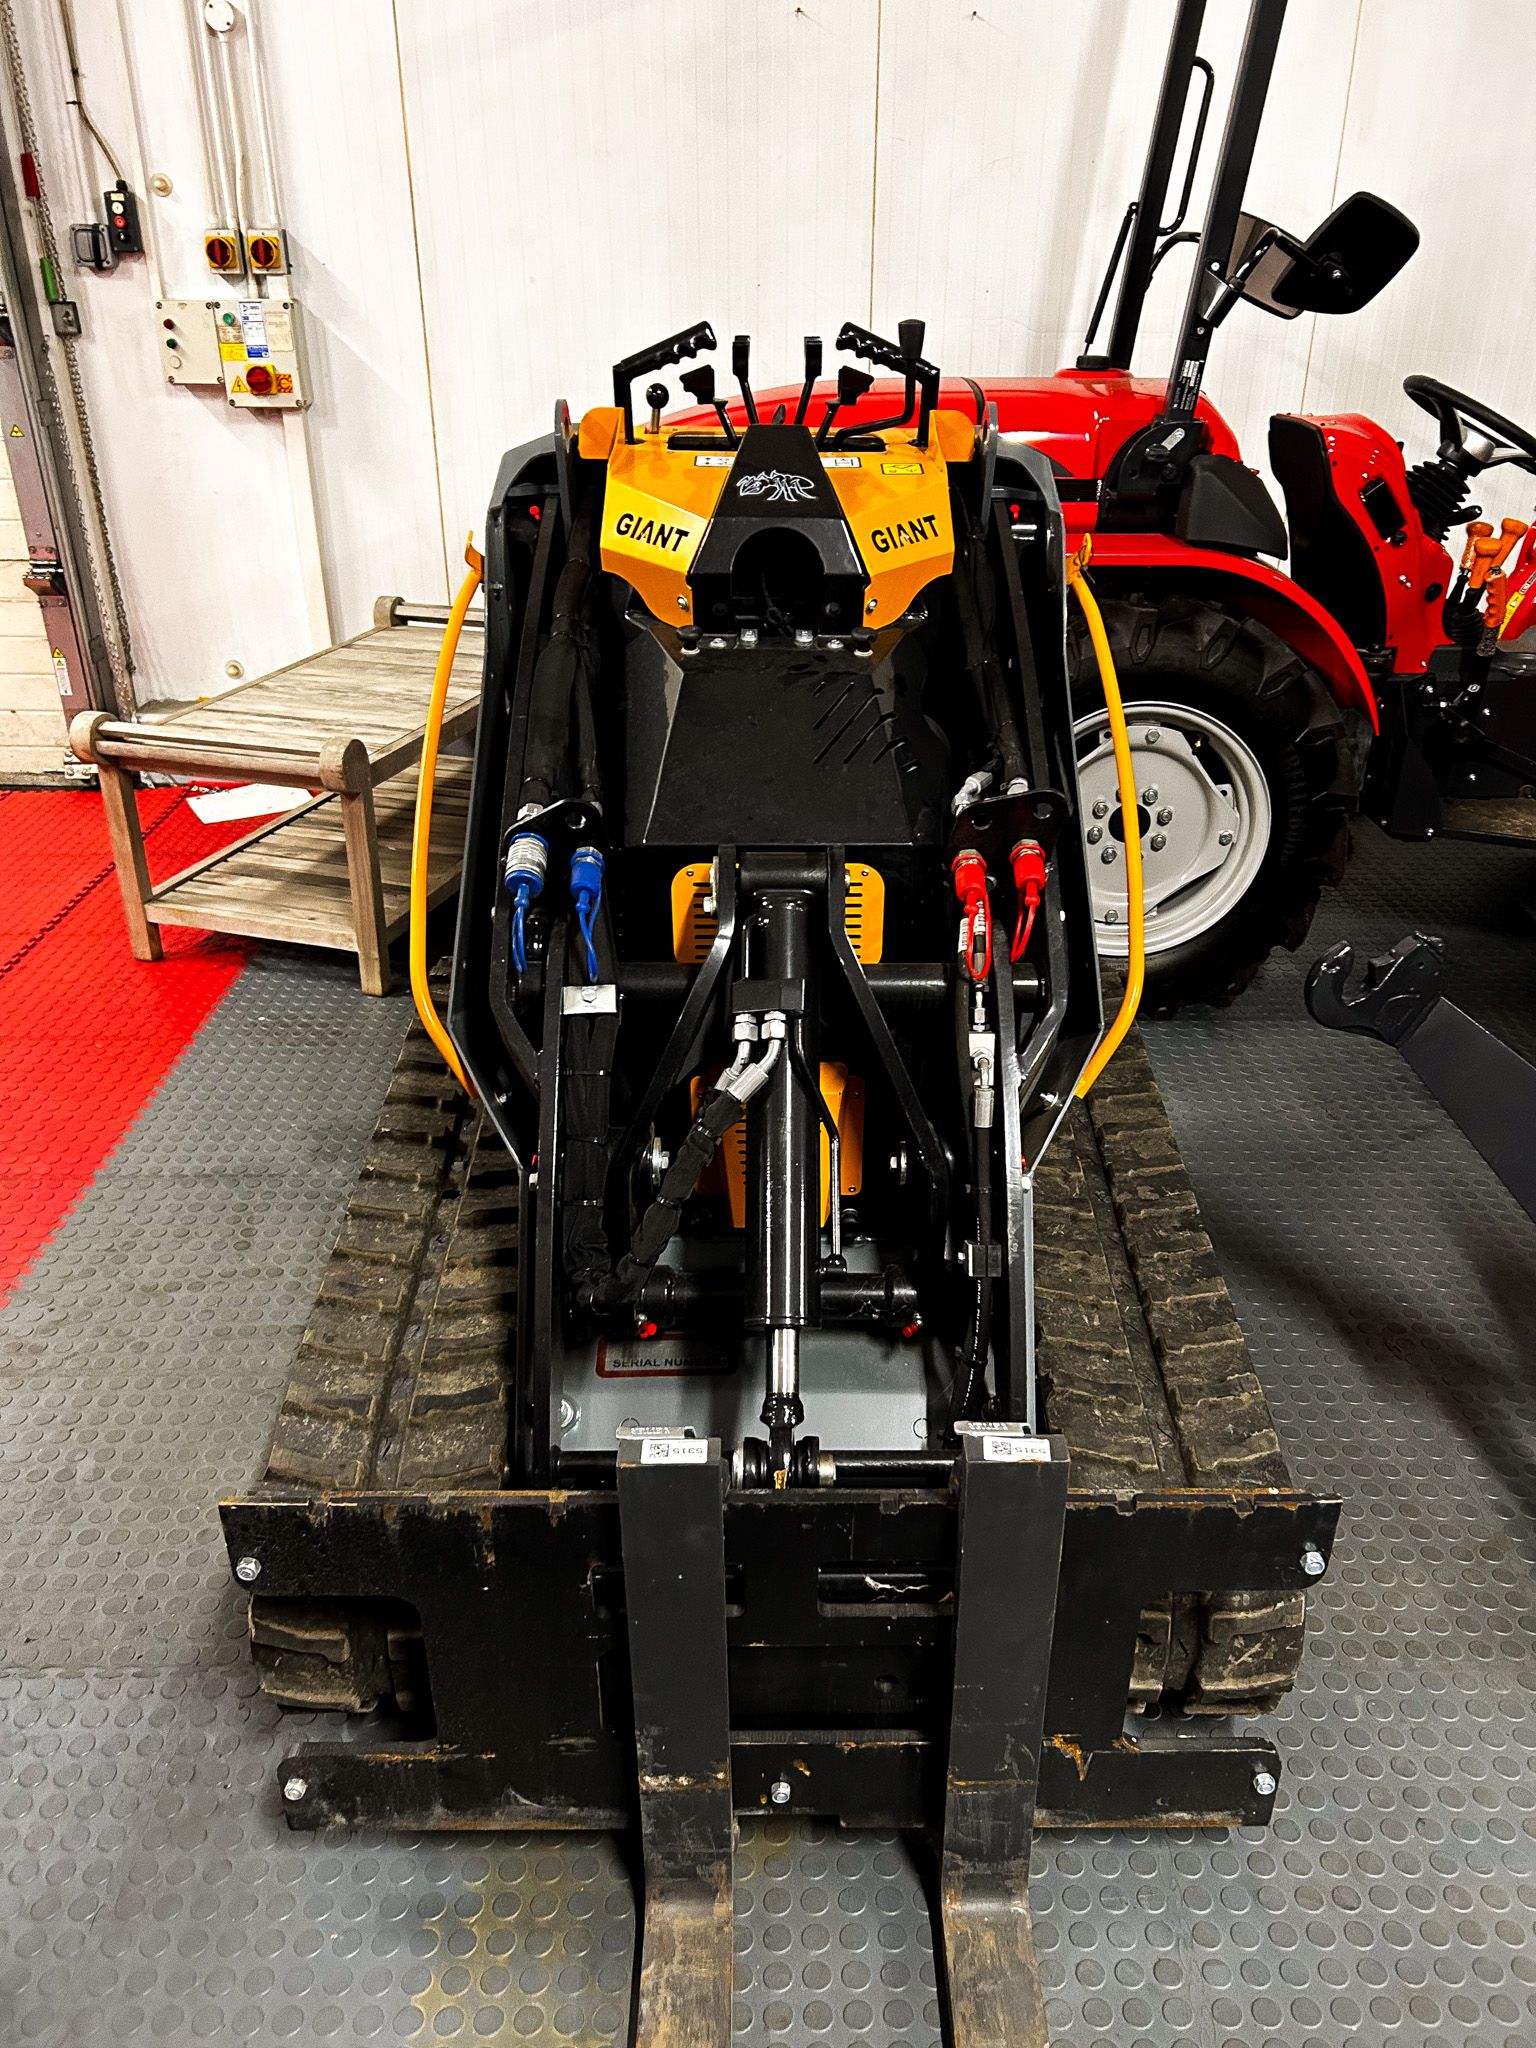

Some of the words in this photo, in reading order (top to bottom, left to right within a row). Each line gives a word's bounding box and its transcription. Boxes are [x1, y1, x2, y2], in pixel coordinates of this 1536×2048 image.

[616, 513, 690, 552] GIANT
[871, 514, 939, 553] GIANT
[612, 1358, 660, 1368] SERIAL
